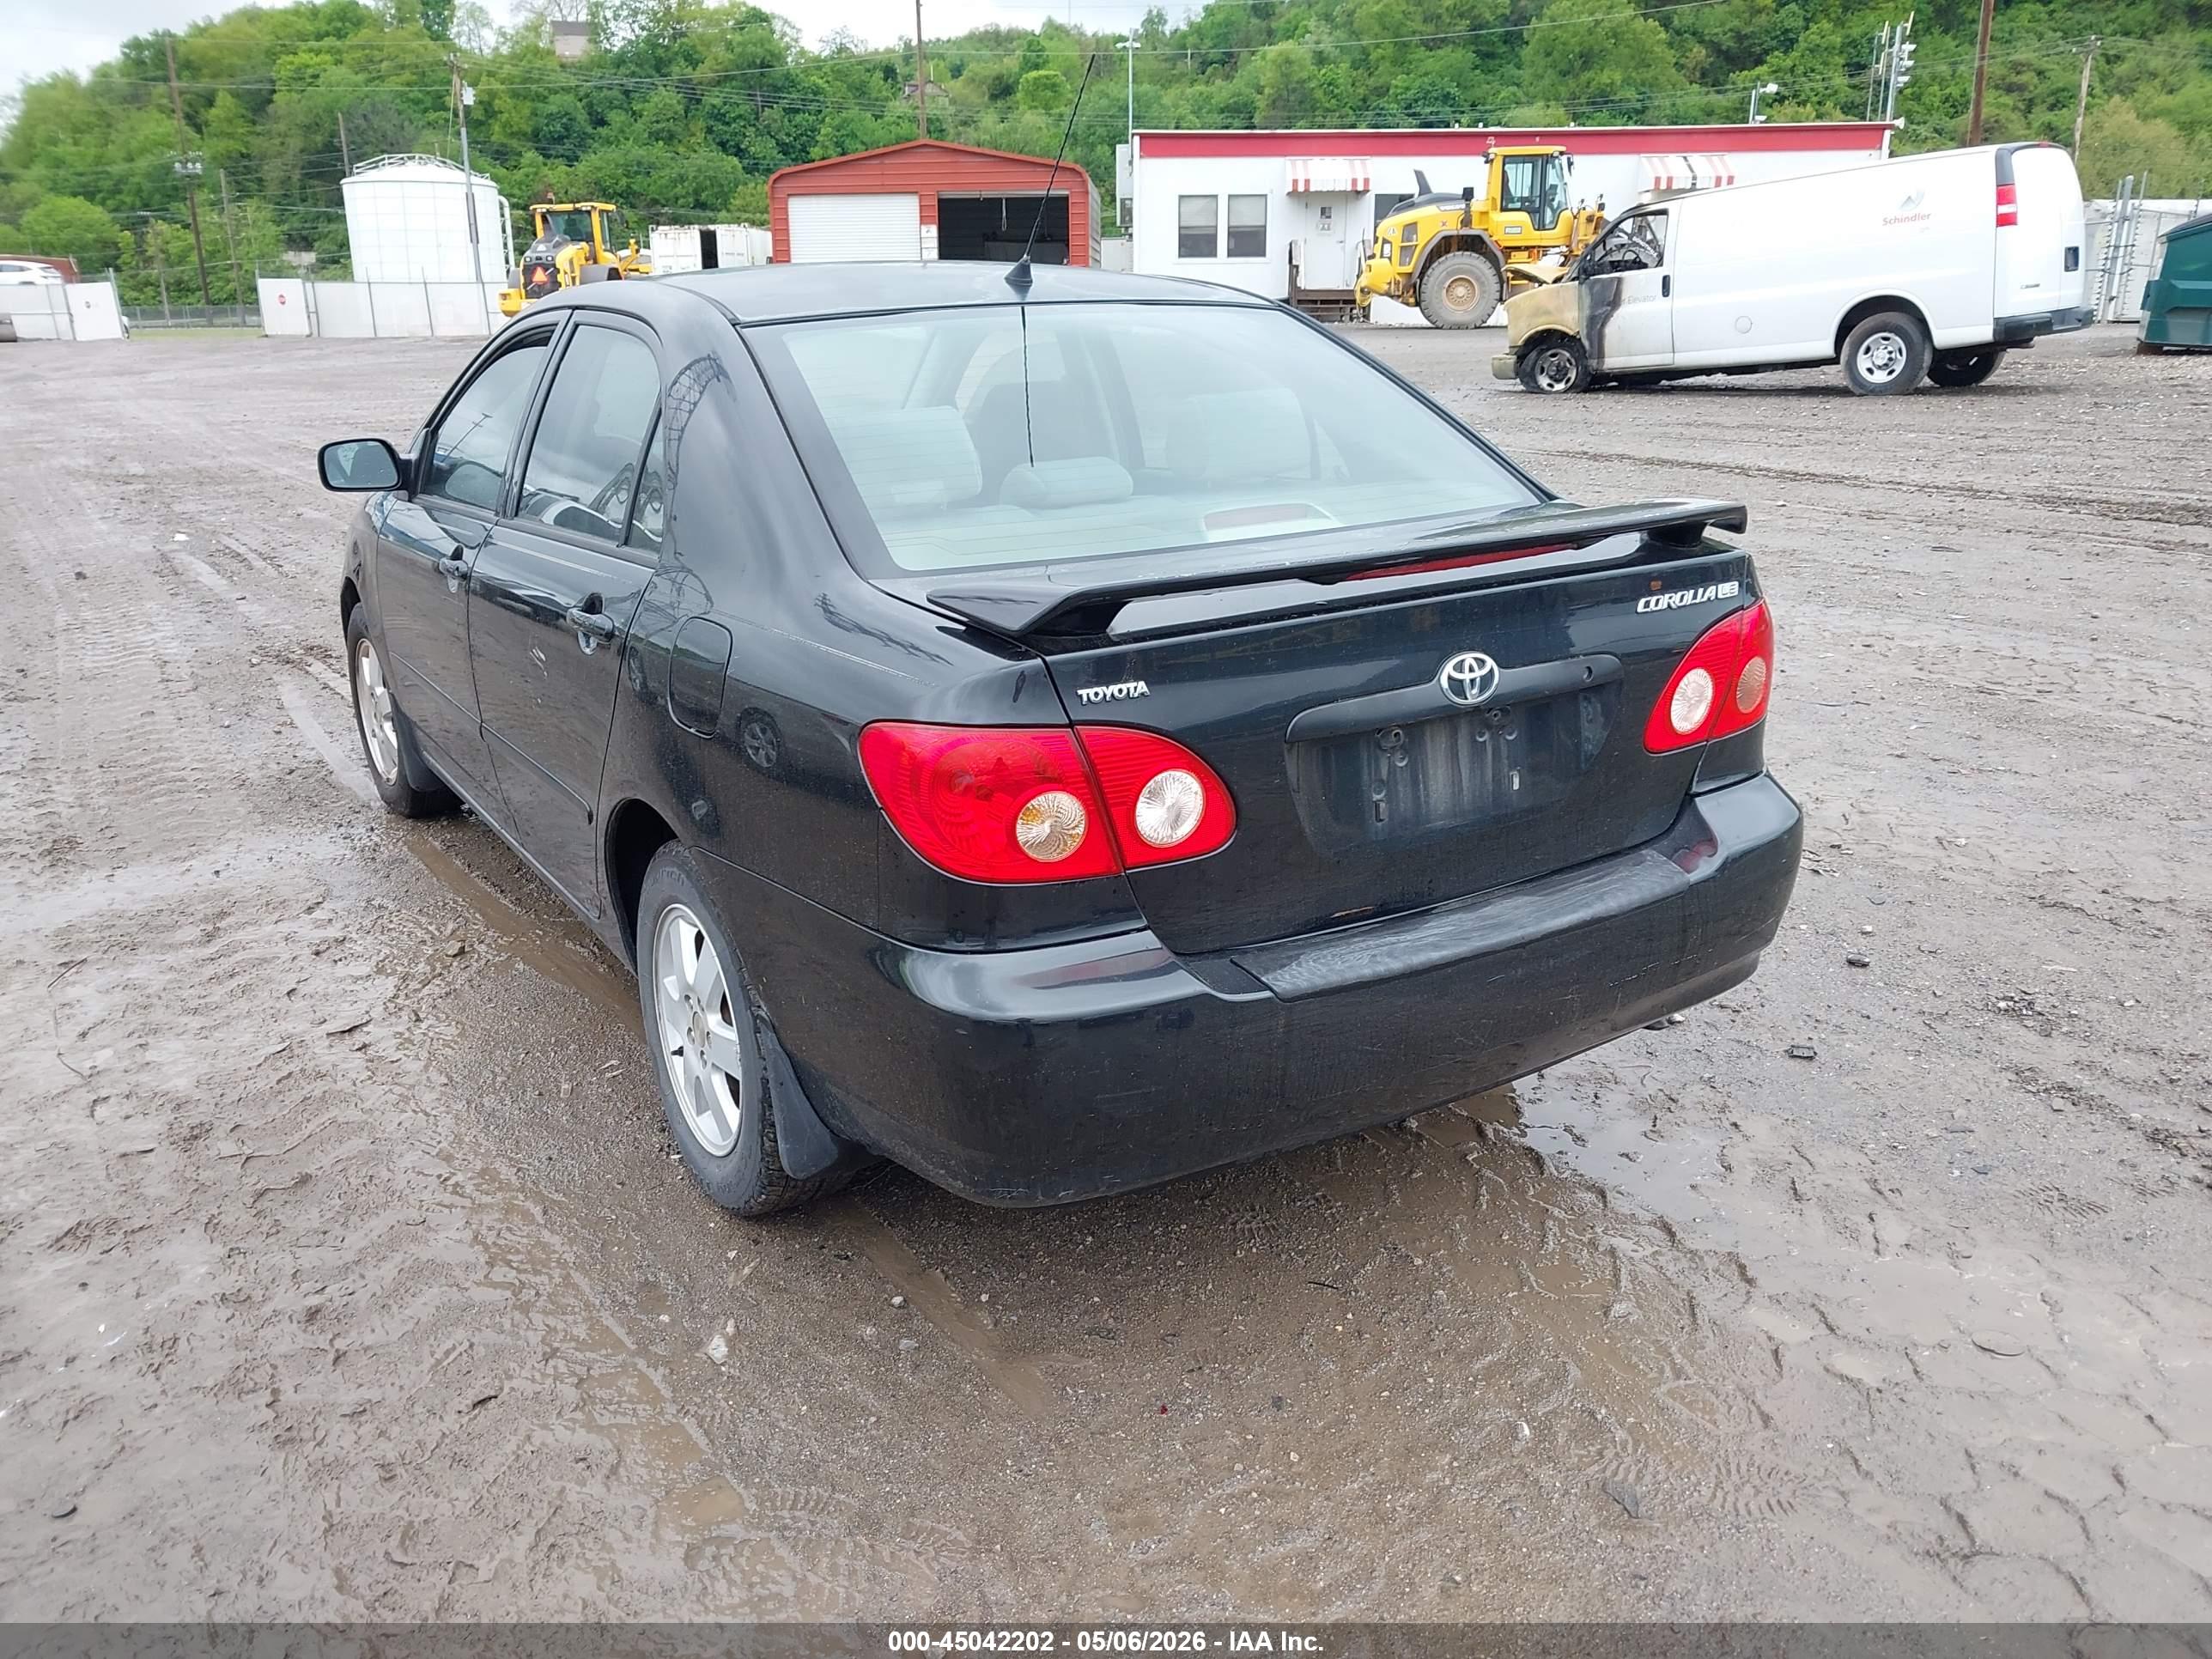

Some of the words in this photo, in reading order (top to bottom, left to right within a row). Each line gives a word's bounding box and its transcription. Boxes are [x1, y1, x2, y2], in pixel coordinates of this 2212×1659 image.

[1881, 212, 1931, 227] Schindler
[1636, 586, 1717, 613] COROLLA
[1077, 680, 1152, 705] TOYOTA
